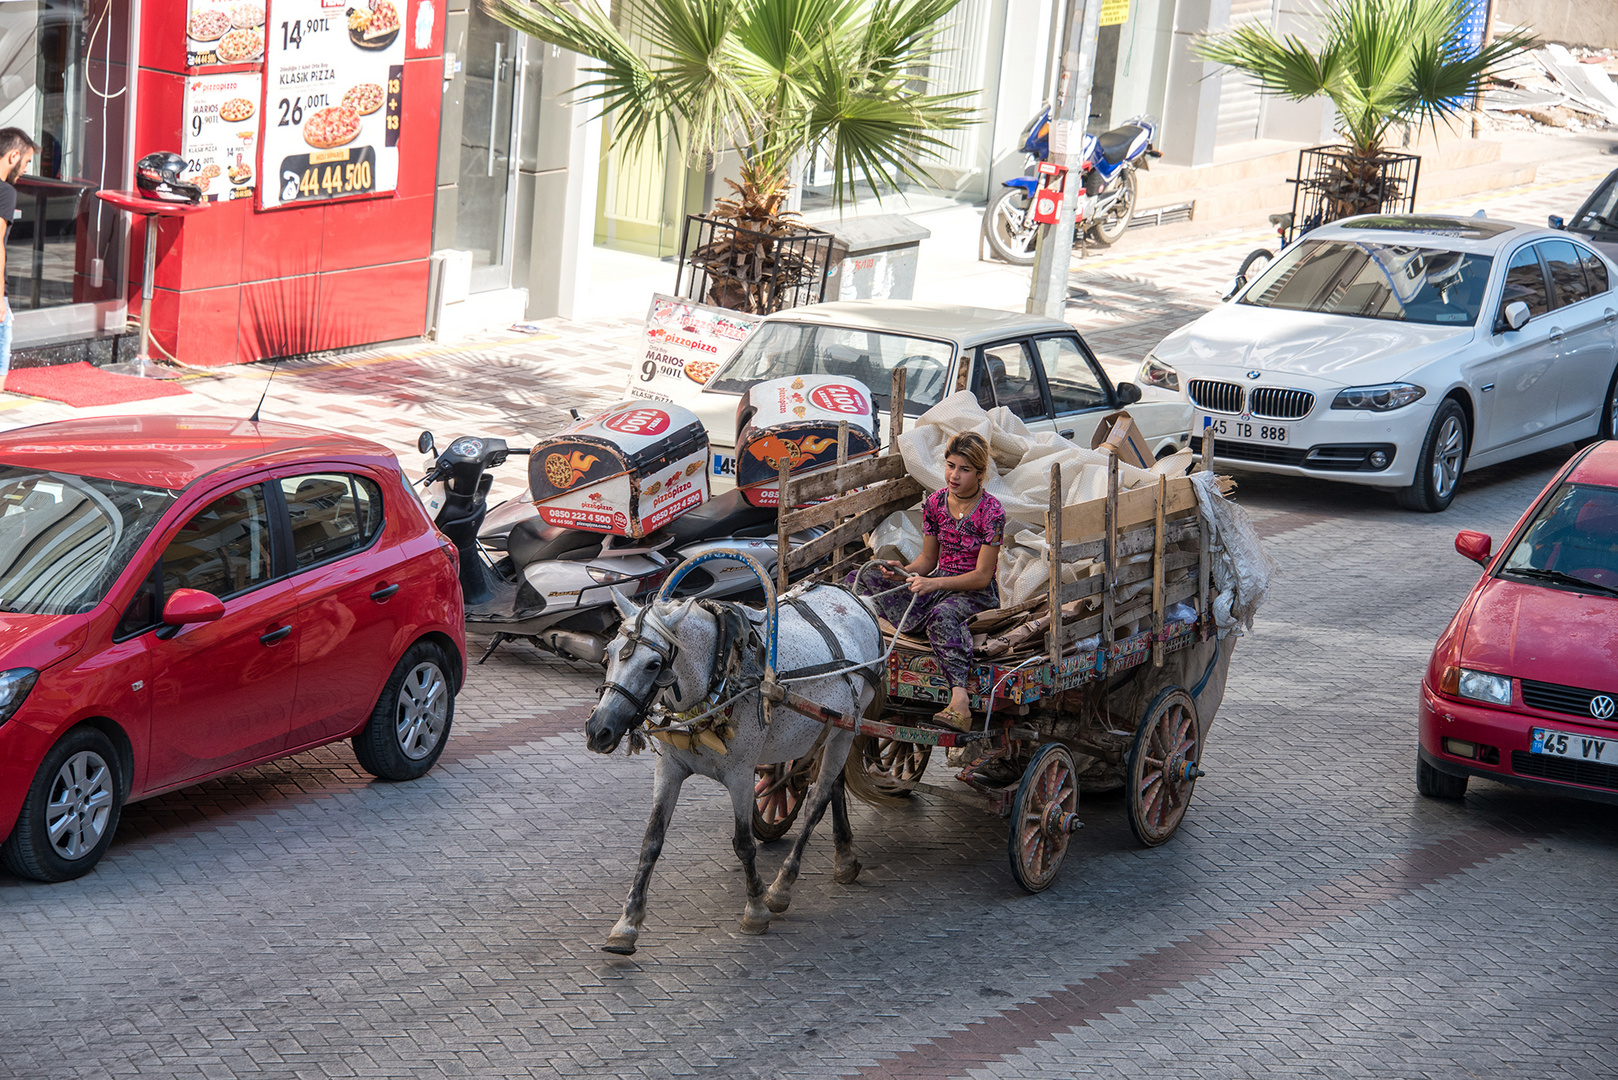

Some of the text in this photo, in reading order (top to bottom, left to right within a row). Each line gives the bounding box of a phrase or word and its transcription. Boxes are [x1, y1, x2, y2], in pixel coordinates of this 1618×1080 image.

[388, 79, 400, 94] 13
[278, 94, 330, 127] 26,00TL
[386, 114, 399, 130] 13
[300, 160, 372, 196] 44 44 500
[665, 334, 718, 353] pizzapizza
[646, 350, 684, 368] MARIOS
[1212, 420, 1286, 441] 45 TB 888
[721, 458, 736, 475] 45
[654, 482, 692, 508] pizzapizza
[760, 490, 779, 498] 085
[581, 502, 613, 511] pizzapizza
[652, 510, 668, 524] 0850
[669, 502, 681, 514] 222
[687, 493, 700, 505] 500
[550, 510, 570, 518] 0850
[572, 512, 586, 520] 222
[594, 515, 611, 524] 500
[1544, 734, 1568, 754] 45
[1582, 739, 1606, 760] VY
